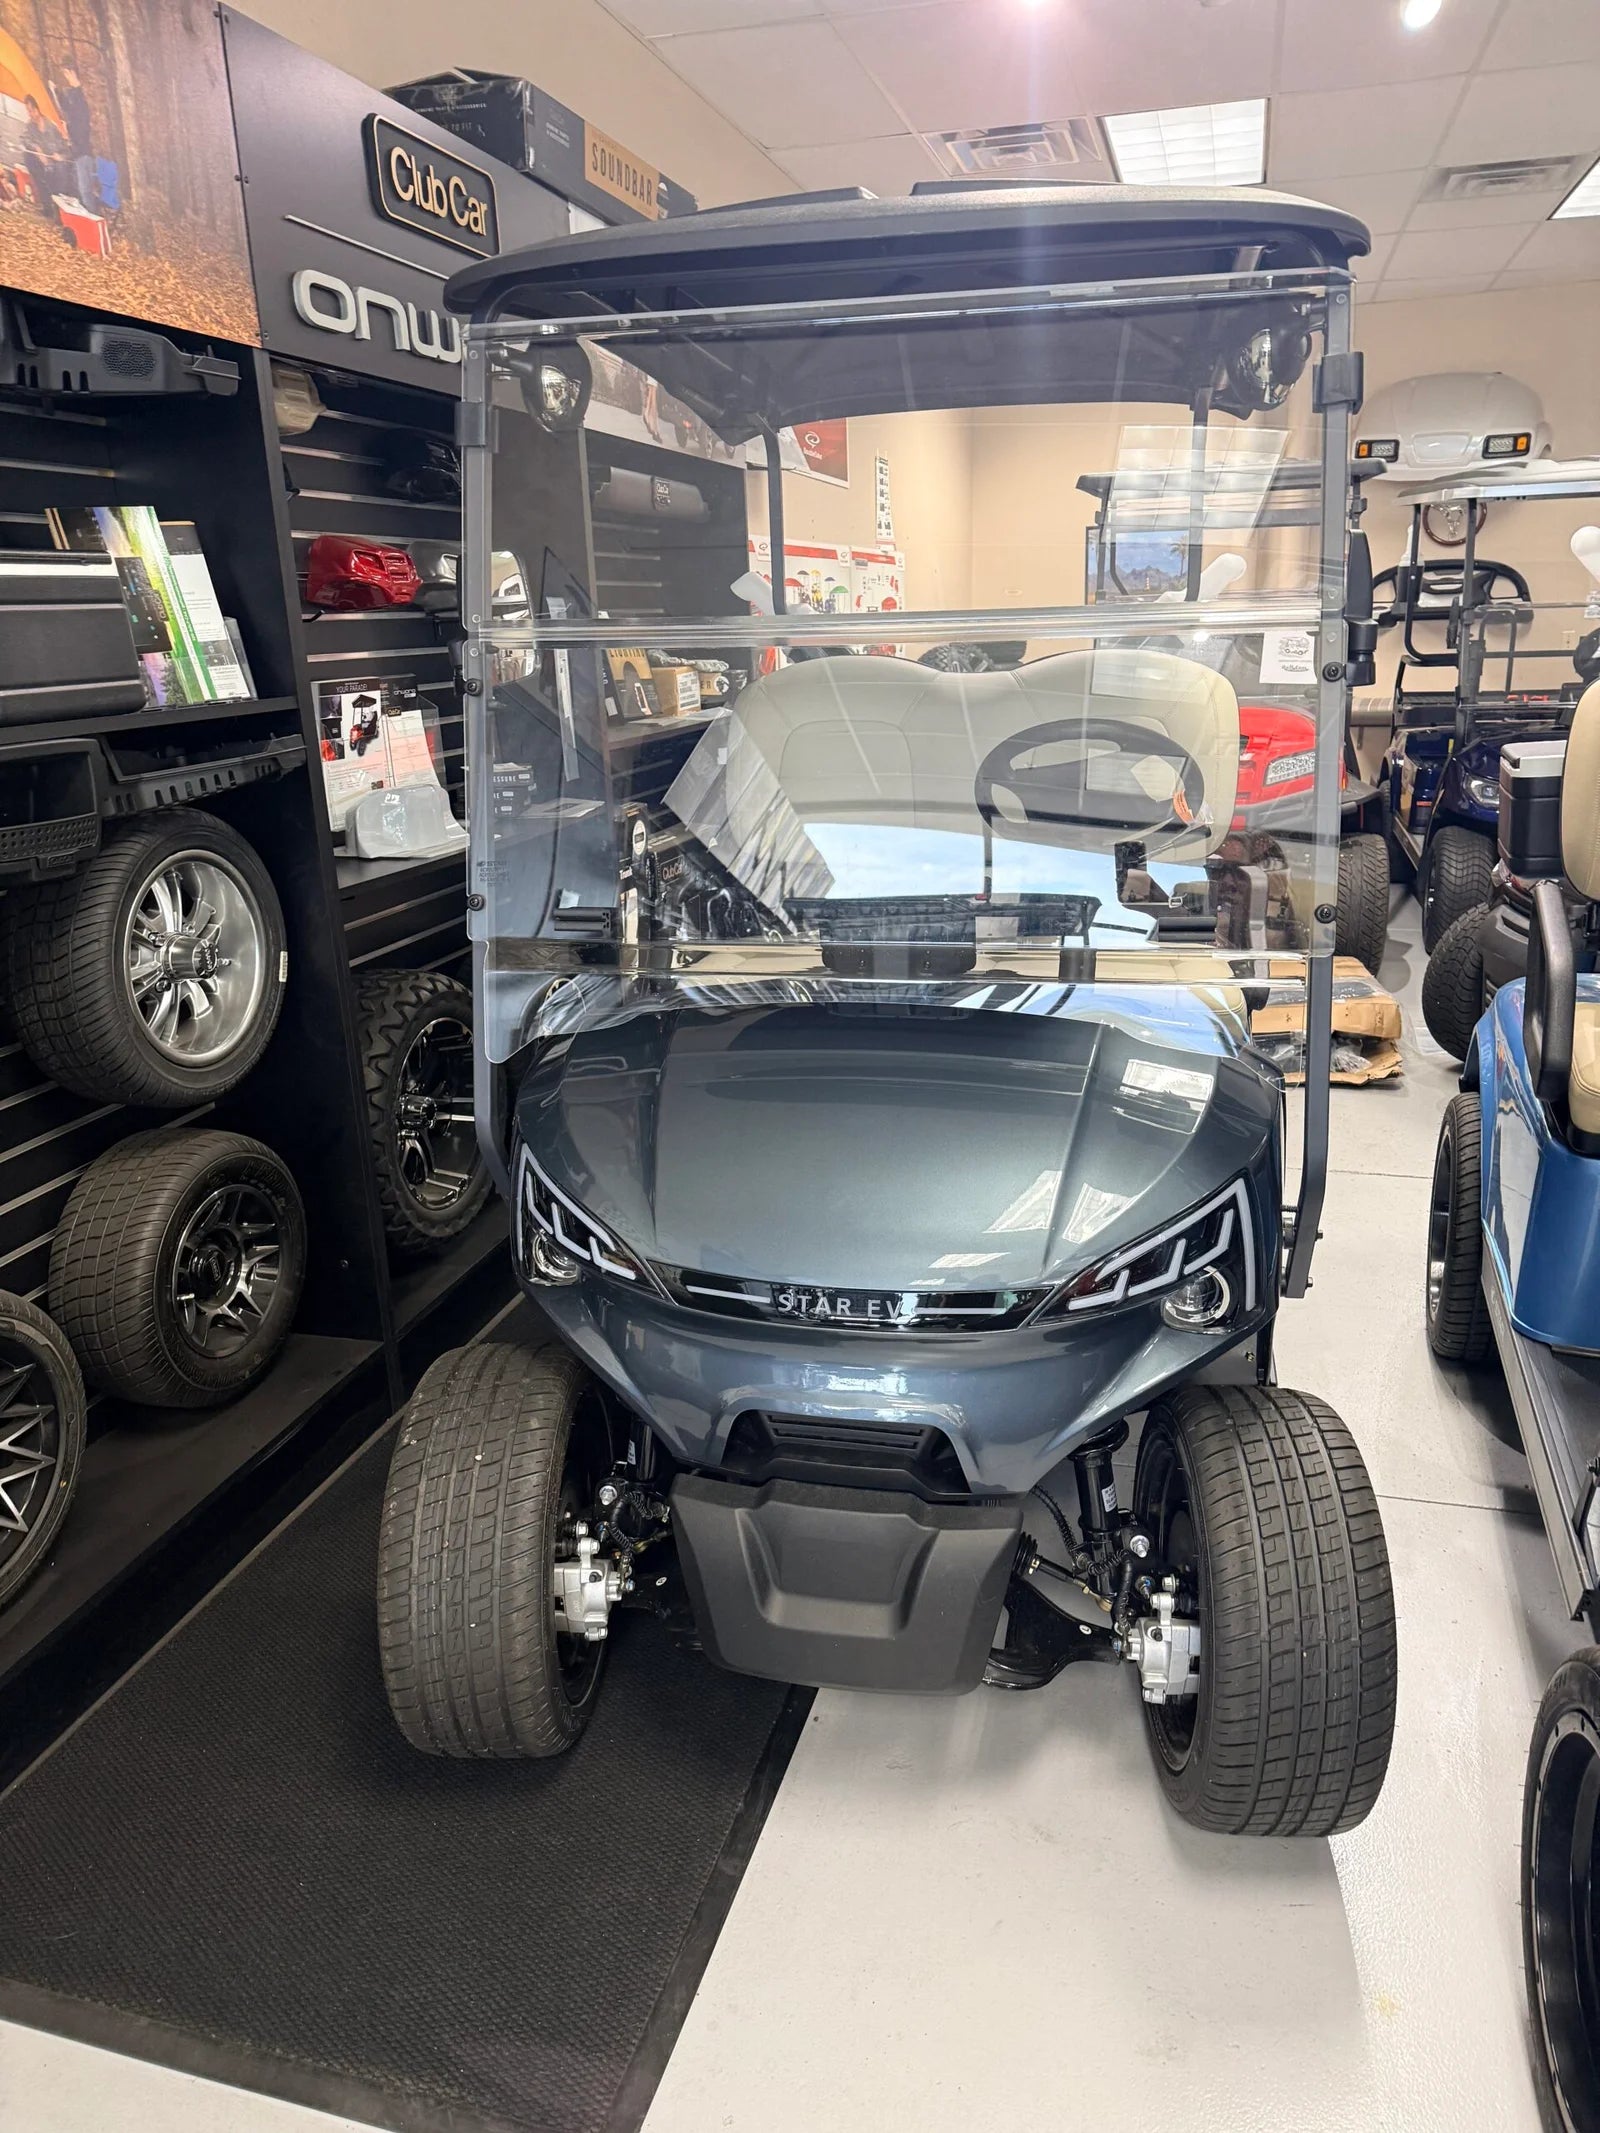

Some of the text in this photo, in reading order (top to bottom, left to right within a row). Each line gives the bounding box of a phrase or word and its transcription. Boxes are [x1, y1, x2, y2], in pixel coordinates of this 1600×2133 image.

[592, 142, 653, 206] SOUNDBAR
[292, 269, 463, 364] onw
[778, 1293, 902, 1320] STAR EV
